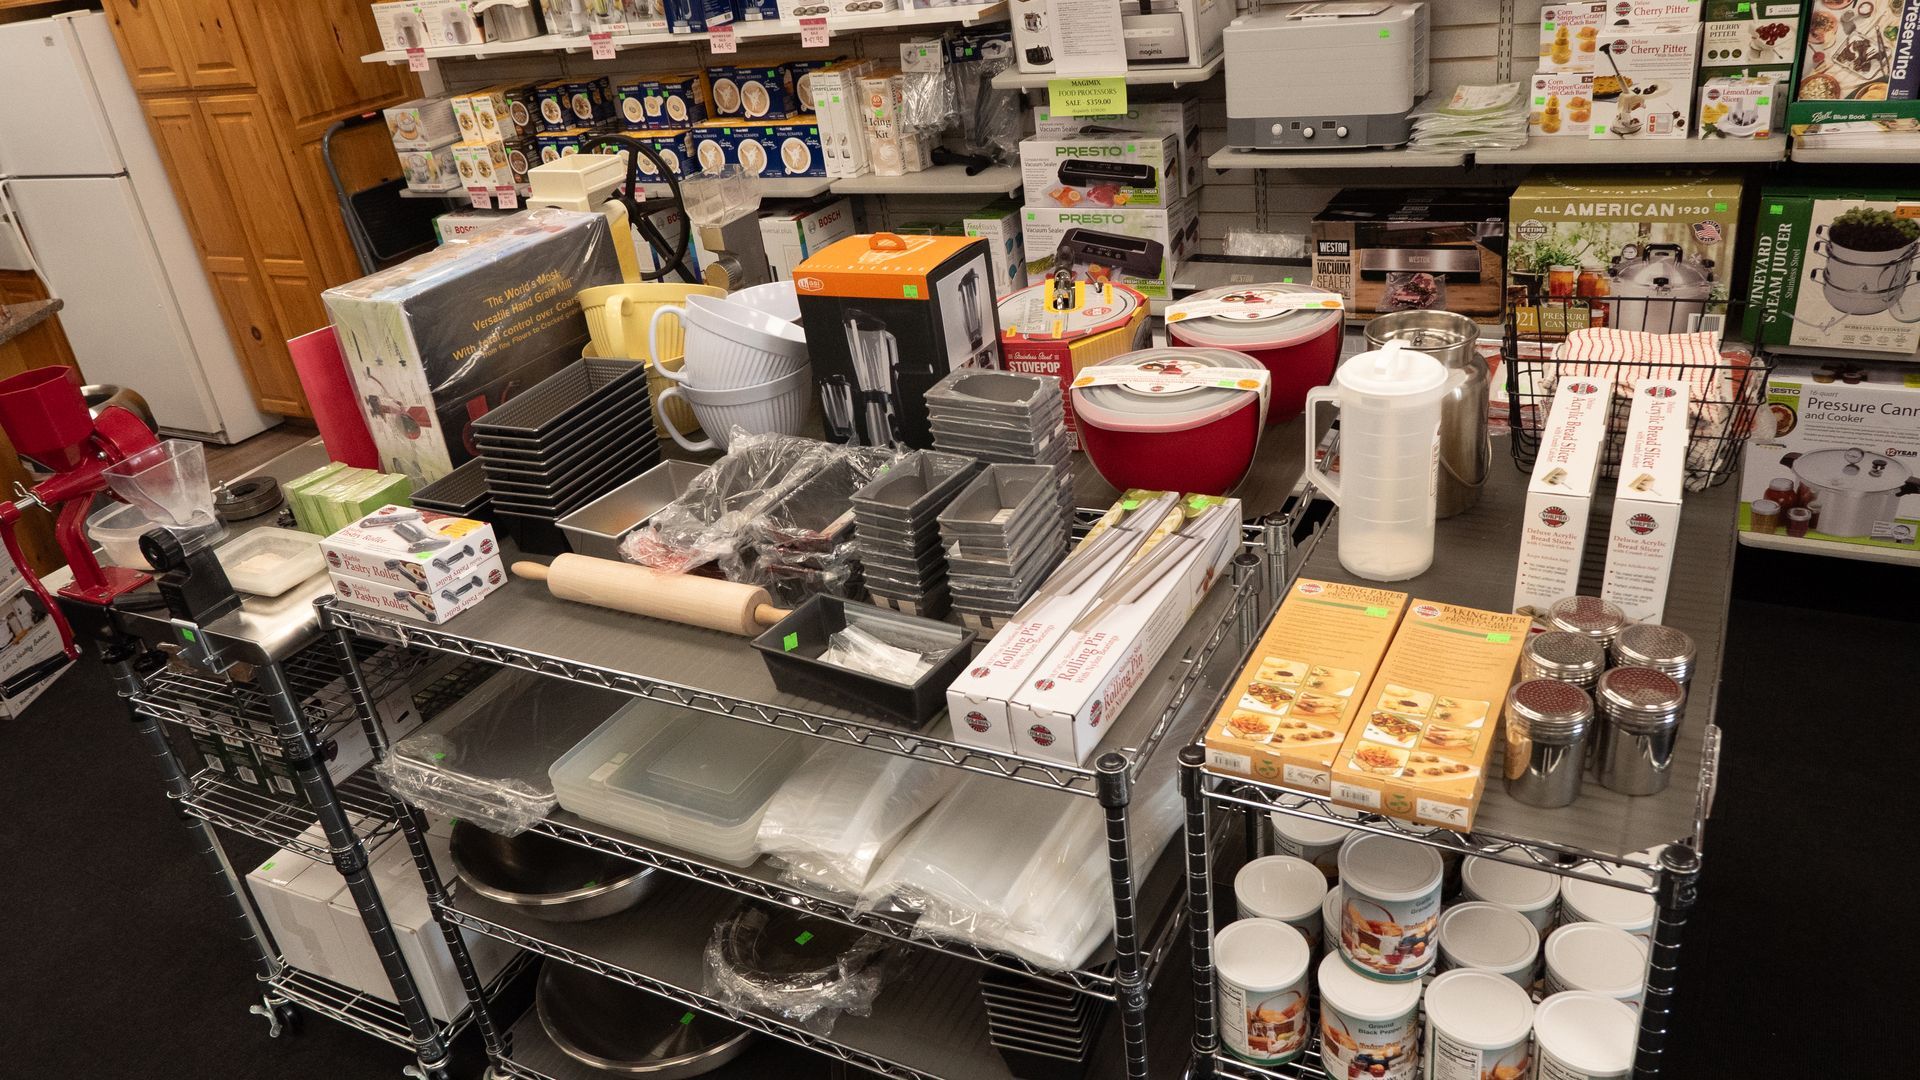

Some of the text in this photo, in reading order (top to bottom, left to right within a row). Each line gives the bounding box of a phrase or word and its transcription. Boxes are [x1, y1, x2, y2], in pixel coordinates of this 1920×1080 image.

[1634, 5, 1690, 17] Cherry Pitter
[1557, 13, 1604, 22] Stripper/Grater
[1631, 44, 1688, 56] Cherry Pitter
[1078, 88, 1118, 96] PROCESSORS
[1722, 88, 1762, 96] Lemon/Lime
[1812, 111, 1833, 122] Ball
[869, 118, 892, 128] Icing
[875, 130, 888, 139] Kit
[1056, 146, 1122, 158] PRESTO
[1534, 203, 1710, 217] ALL AMERICAN 1930
[666, 212, 682, 224] BOS
[818, 209, 842, 228] BOSCH
[1059, 214, 1124, 225] PRESTO
[1320, 242, 1348, 253] WESTON
[1408, 256, 1430, 264] WESTON
[1317, 263, 1350, 275] VACUUM
[1750, 235, 1773, 308] VINEYARD
[1765, 223, 1793, 323] STEAM JUICER
[1785, 248, 1801, 299] Stainless Steel
[504, 279, 536, 300] World's
[537, 269, 562, 285] Most
[1316, 276, 1350, 289] SEALER
[472, 308, 511, 332] Versatile
[512, 297, 534, 314] Hand
[534, 286, 557, 303] Grain
[1543, 312, 1588, 321] PRESSURE
[452, 341, 477, 362] With
[502, 316, 534, 338] control
[535, 308, 554, 322] over
[556, 294, 580, 312] Coars
[533, 326, 540, 334] to
[1544, 321, 1584, 329] CANNER
[1014, 352, 1052, 360] Stainless Steel
[1008, 361, 1060, 373] STOVEPOP
[1807, 398, 1920, 416] Pressure Cann
[1804, 412, 1864, 424] and Cooker
[1557, 397, 1586, 464] Acrylic Bread Slicer
[1643, 400, 1666, 469] Acrylic Bread Slicer
[1541, 512, 1568, 520] NORPRO
[1630, 520, 1657, 528] NORPRO
[364, 534, 387, 544] Roller
[1527, 528, 1577, 540] Deluxe Acrylic
[1551, 538, 1572, 546] Slicer
[1614, 535, 1667, 548] Deluxe Acrylic
[1618, 543, 1638, 551] Bread
[341, 552, 361, 564] Marble
[344, 560, 400, 582] Pastry Roller
[435, 574, 452, 588] Roller
[351, 583, 370, 594] Marble
[1326, 583, 1403, 600] BAKING PAPER
[354, 589, 410, 612] Pastry Roller
[444, 604, 462, 618] Roller
[1444, 606, 1527, 624] BAKING PAPER
[993, 622, 1043, 668] Rolling Pin
[1058, 632, 1106, 681] Rolling Pin
[1102, 653, 1144, 712] Rolling Pin
[1358, 1028, 1378, 1036] Black
[1368, 1022, 1394, 1030] Ground
